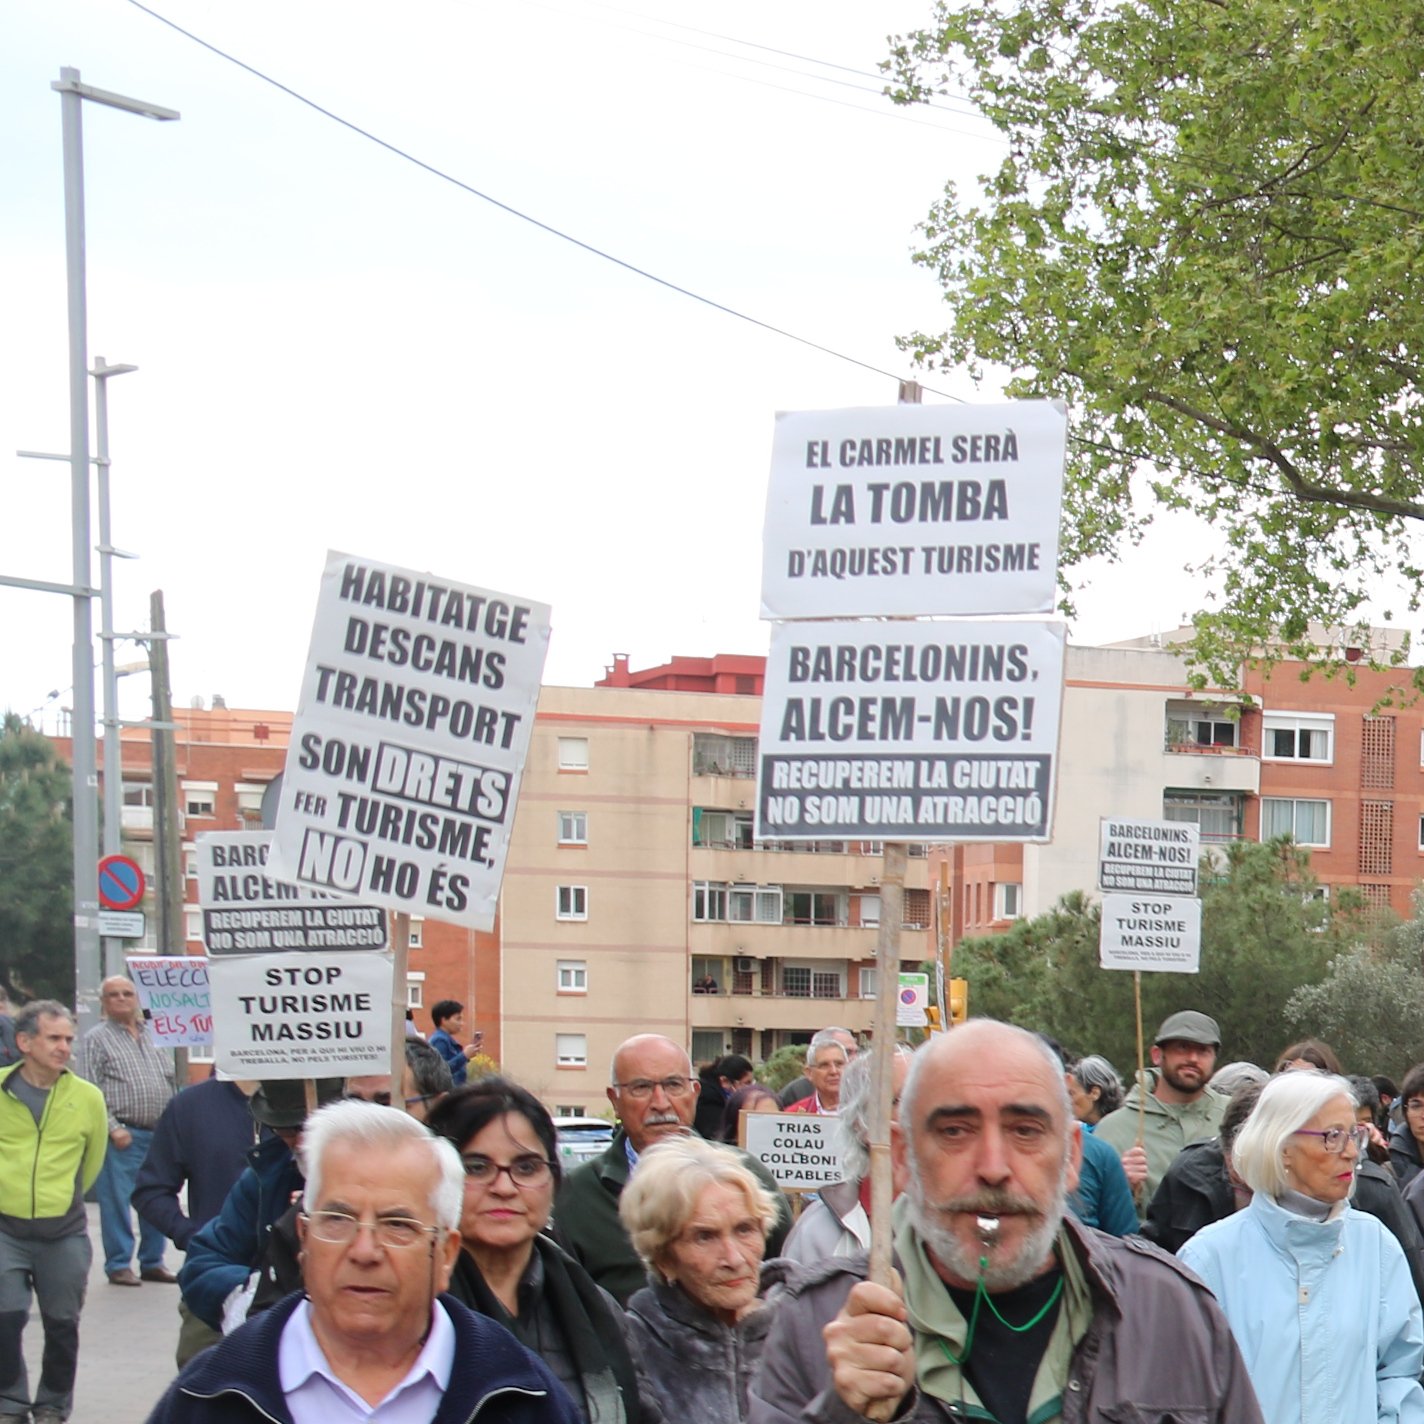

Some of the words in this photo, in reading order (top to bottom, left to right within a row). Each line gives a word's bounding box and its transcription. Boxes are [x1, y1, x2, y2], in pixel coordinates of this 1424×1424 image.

[806, 440, 832, 468] EL
[839, 436, 943, 467] CARMEL
[951, 428, 1019, 464] SERÀ
[810, 484, 856, 525] LA
[867, 479, 1009, 524] TOMBA
[788, 546, 914, 580] D'AQUEST
[921, 542, 1040, 574] TURISME
[339, 563, 531, 645] HABITATGE
[344, 615, 506, 690] DESCANS
[788, 644, 1038, 683] BARCELONINS,
[316, 664, 522, 750] TRANSPORT
[779, 695, 1035, 742] ALCEM-NOS!
[299, 733, 371, 784] SON
[376, 747, 506, 819] DRETS
[772, 761, 914, 790] RECUPEREM
[919, 761, 949, 789] LA
[953, 760, 1041, 789] CIUTAT
[767, 795, 800, 825] NO
[803, 795, 859, 825] SOM
[864, 796, 914, 825] UNA
[917, 791, 1043, 826] ATRACCIÓ
[294, 791, 327, 818] FER
[337, 790, 495, 870] TURISME,
[1107, 842, 1191, 863] ALCEM-NOS!
[301, 830, 365, 890] NO
[370, 855, 420, 899] HO
[426, 863, 469, 912] ÉS
[210, 909, 302, 929] RECUPEREM
[305, 909, 325, 927] LA
[326, 908, 380, 926] CIUTAT
[1132, 902, 1172, 915] STOP
[209, 931, 232, 949] NO
[234, 930, 271, 949] SOM
[273, 929, 304, 947] UNA
[307, 925, 383, 946] ATRACCIÓ
[1116, 918, 1186, 932] TURISME
[1121, 935, 1180, 949] MASSIU
[266, 967, 342, 986] STOP
[238, 993, 371, 1015] TURISME
[251, 1021, 363, 1042] MASSIU
[776, 1122, 822, 1134] TRIAS
[773, 1137, 824, 1150] COLAU
[760, 1153, 837, 1166] COLLBONI
